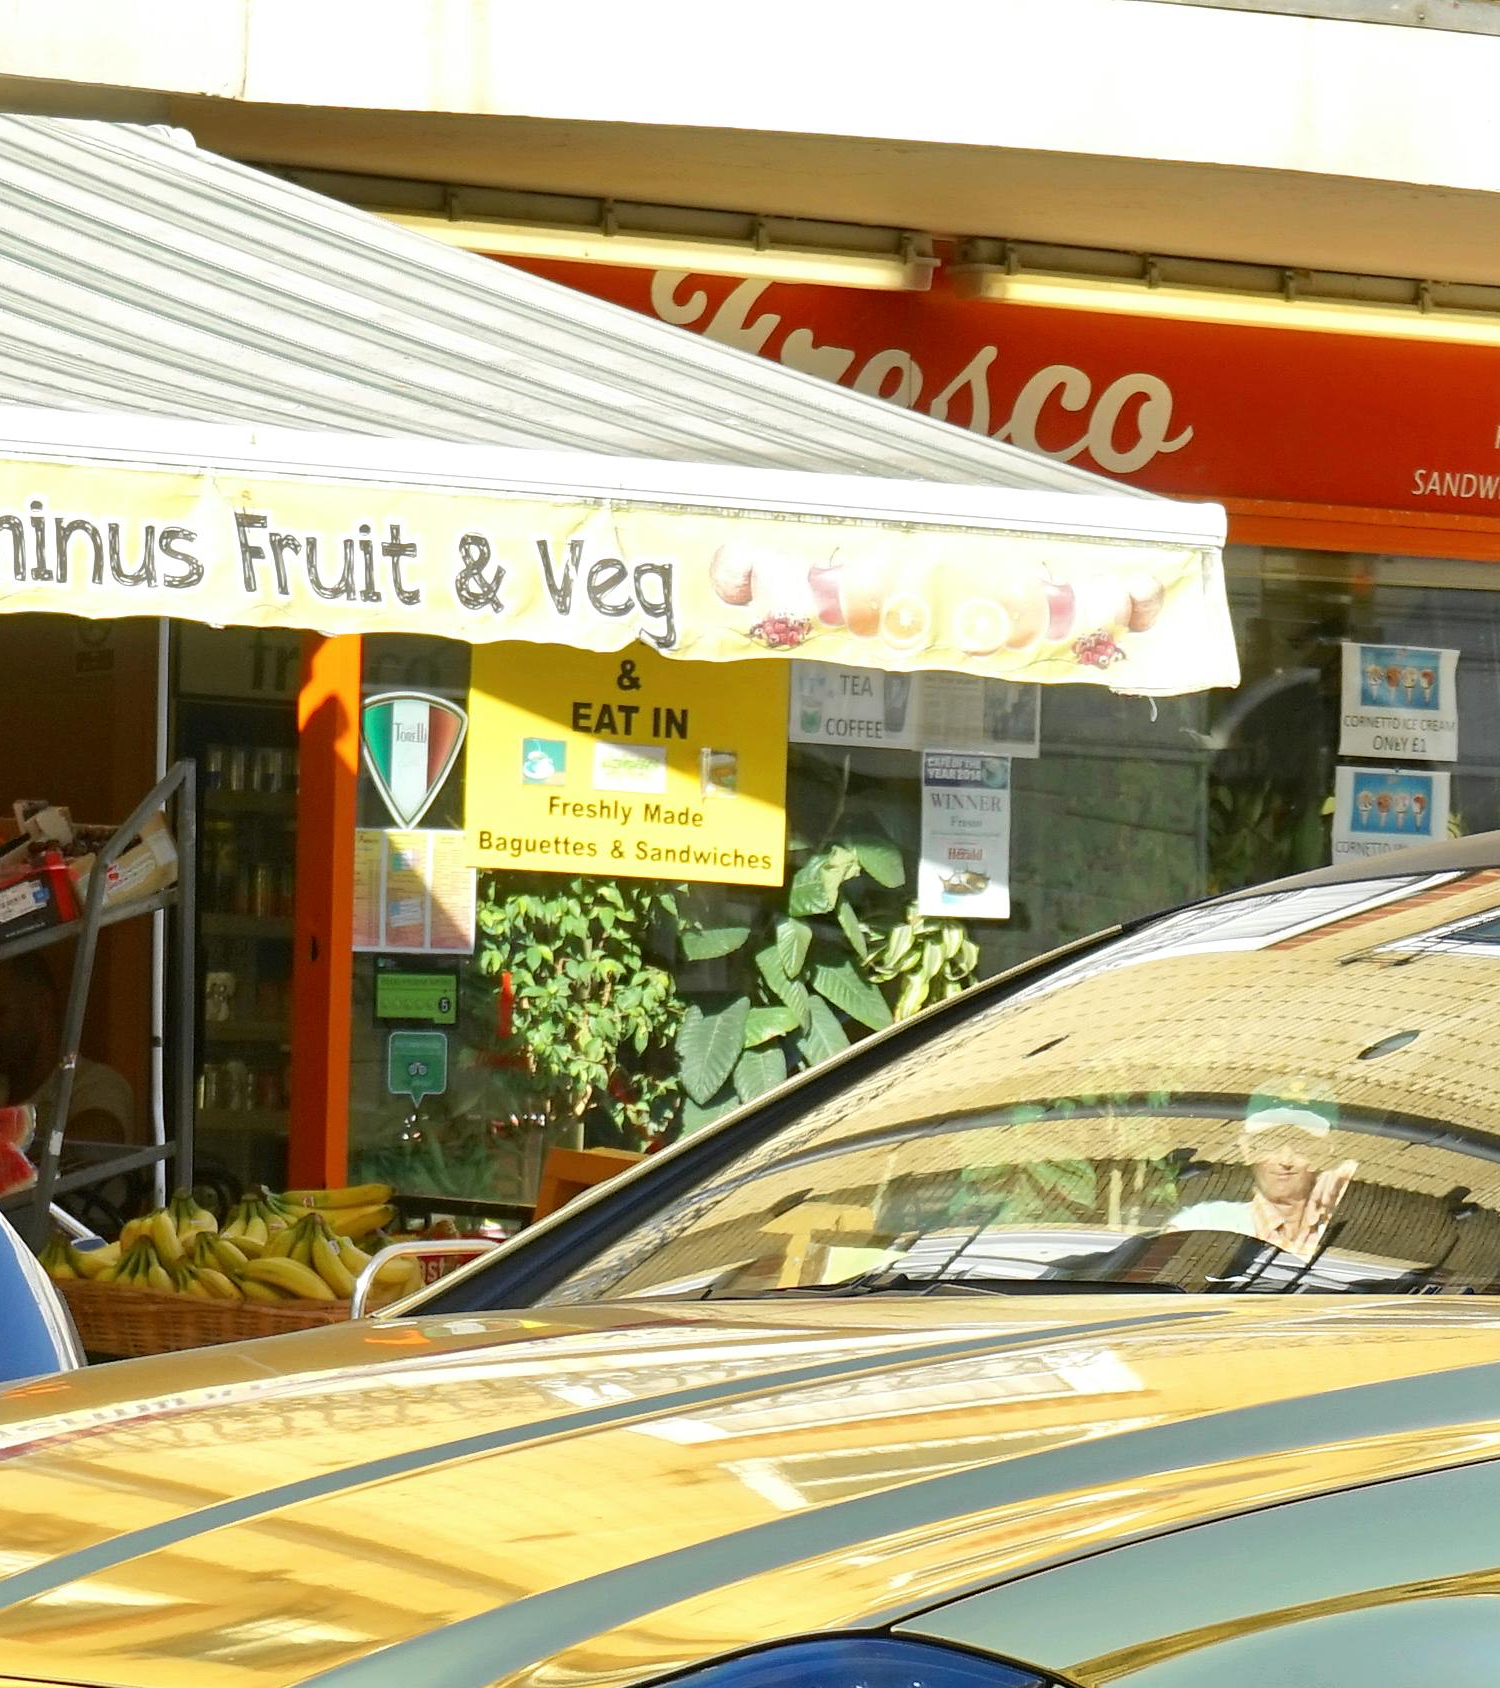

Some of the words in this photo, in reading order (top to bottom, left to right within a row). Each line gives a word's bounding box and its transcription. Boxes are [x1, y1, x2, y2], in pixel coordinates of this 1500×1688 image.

[234, 511, 422, 606] Fruit
[454, 533, 506, 614] &
[535, 538, 675, 650] Veg
[616, 659, 641, 691] &
[840, 674, 874, 697] TEA
[571, 701, 639, 737] EAT
[652, 707, 689, 740] IN
[825, 717, 884, 739] COFFEE
[1343, 714, 1399, 730] CORNETTO
[1372, 735, 1409, 753] ONLY
[549, 797, 632, 826] Freshly
[644, 803, 704, 827] Made
[930, 792, 1002, 813] WINNER
[479, 831, 598, 858] Baguettes
[610, 840, 624, 860] &
[636, 841, 772, 870] Sandwiches
